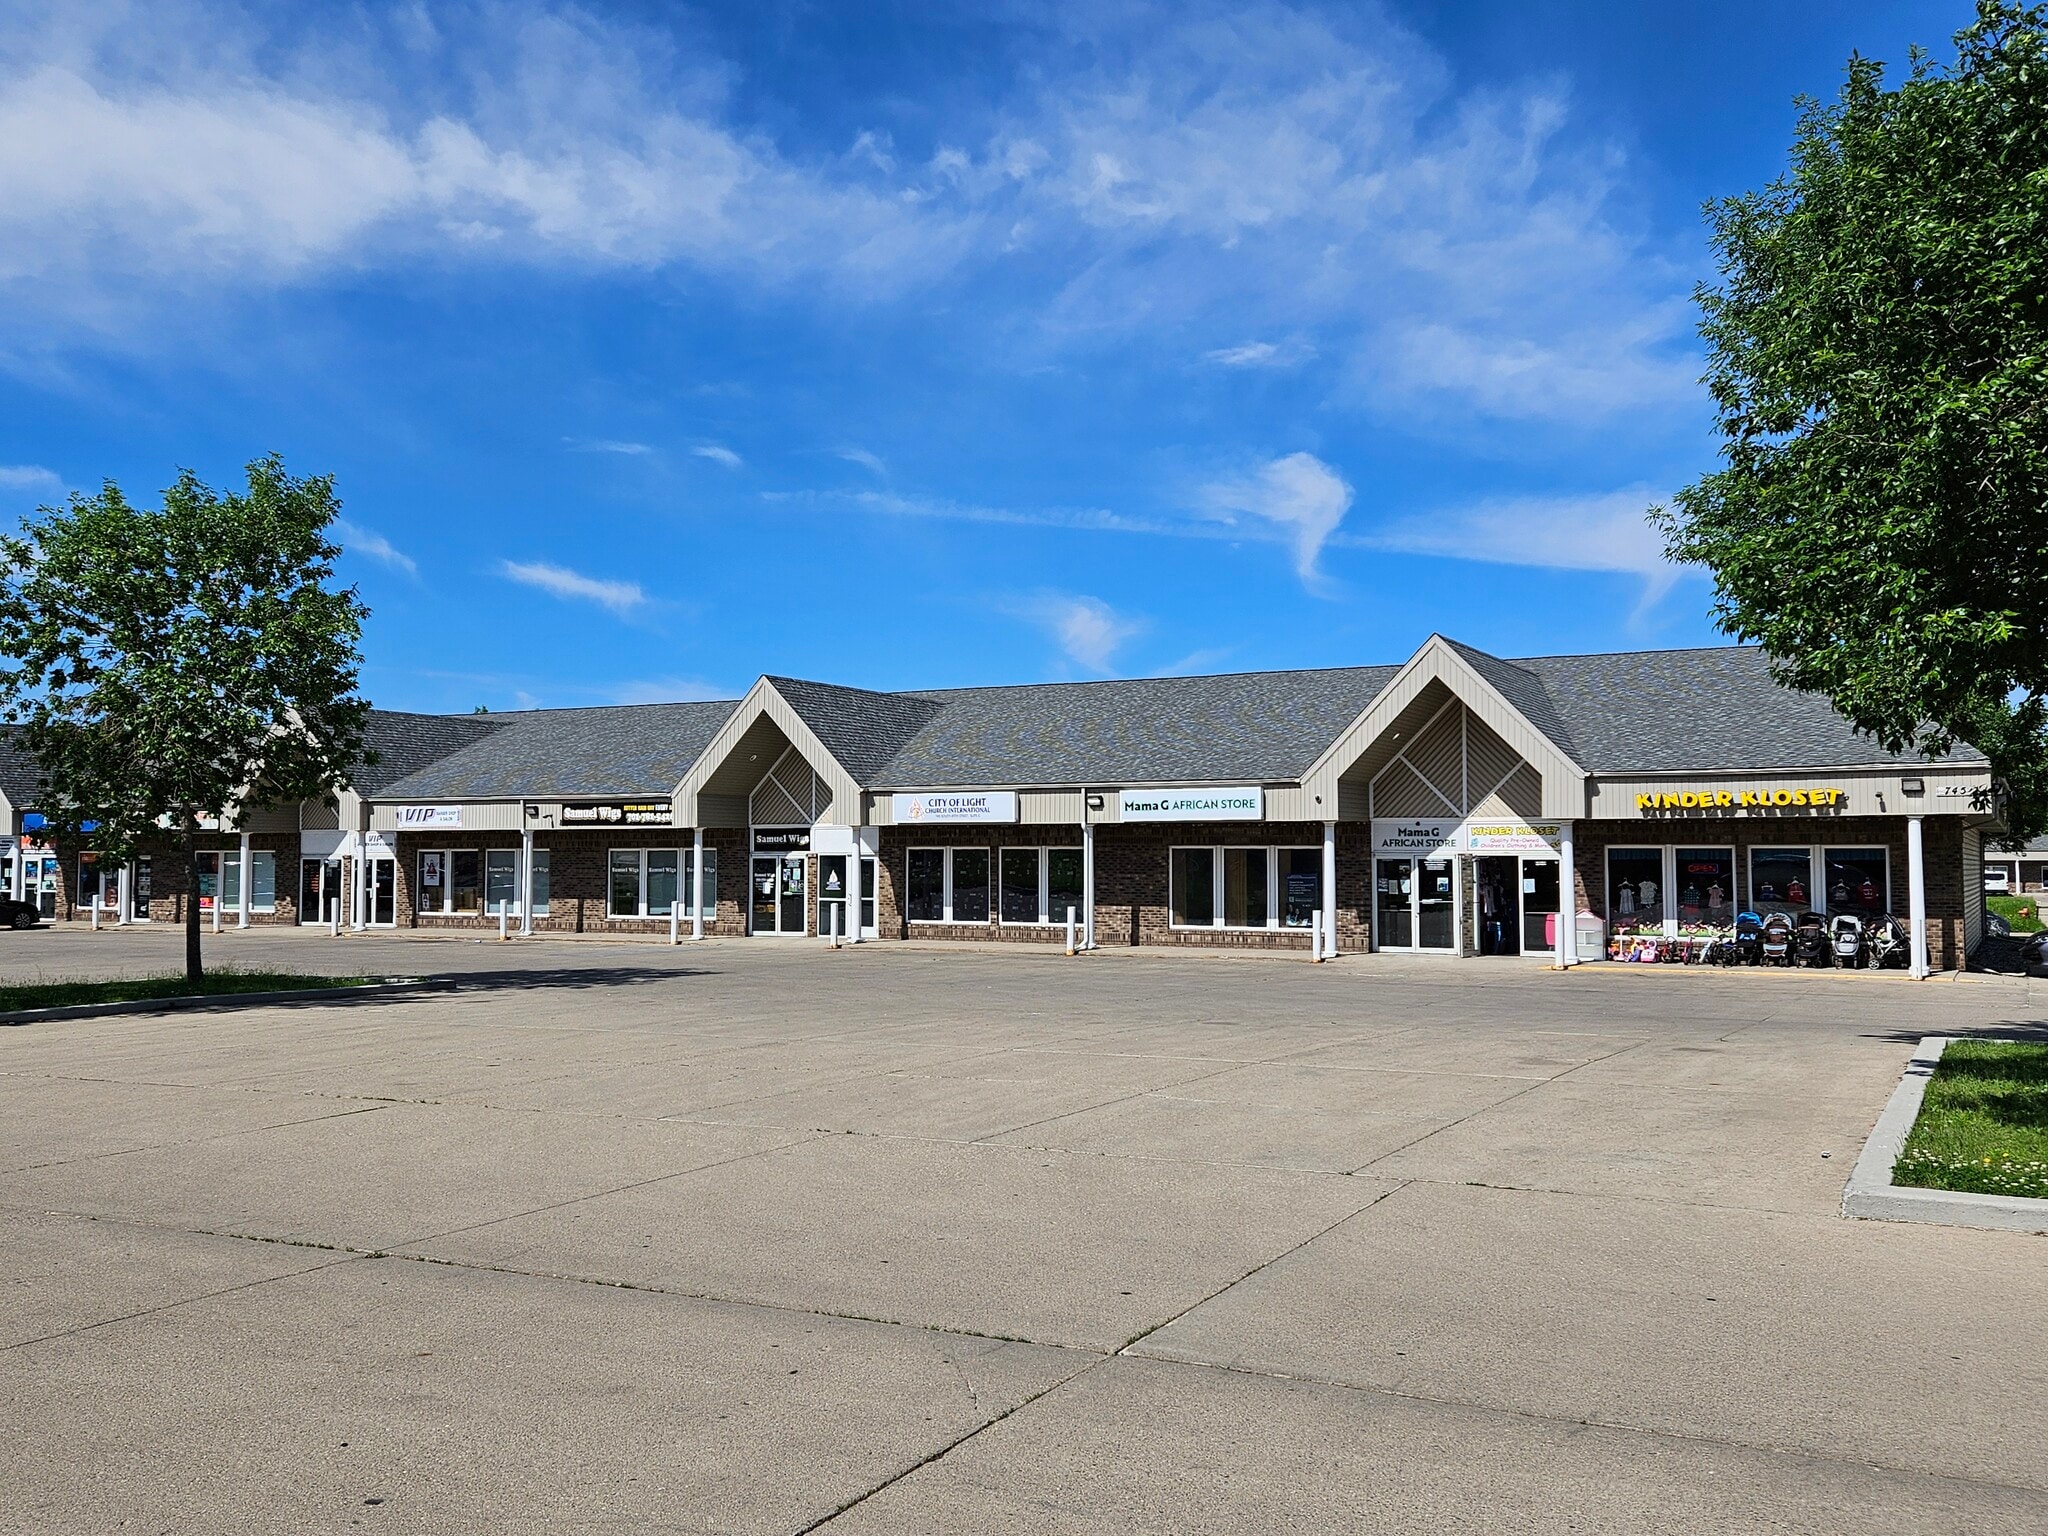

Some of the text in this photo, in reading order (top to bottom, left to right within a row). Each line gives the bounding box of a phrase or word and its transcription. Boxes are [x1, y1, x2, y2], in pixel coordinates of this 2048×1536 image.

[928, 797, 986, 807] CITY OF LIGHT
[1636, 787, 1843, 809] KINDER KLOSET
[1125, 799, 1256, 811] Mama G AFRICAN STORE
[405, 808, 436, 822] VIP
[563, 806, 622, 822] Samuel Wigs
[1398, 827, 1440, 837] Mama G
[1471, 826, 1560, 836] KINDER KLOSET
[756, 834, 809, 845] Samuel Wigs
[1382, 839, 1457, 847] AFRICAN STORE
